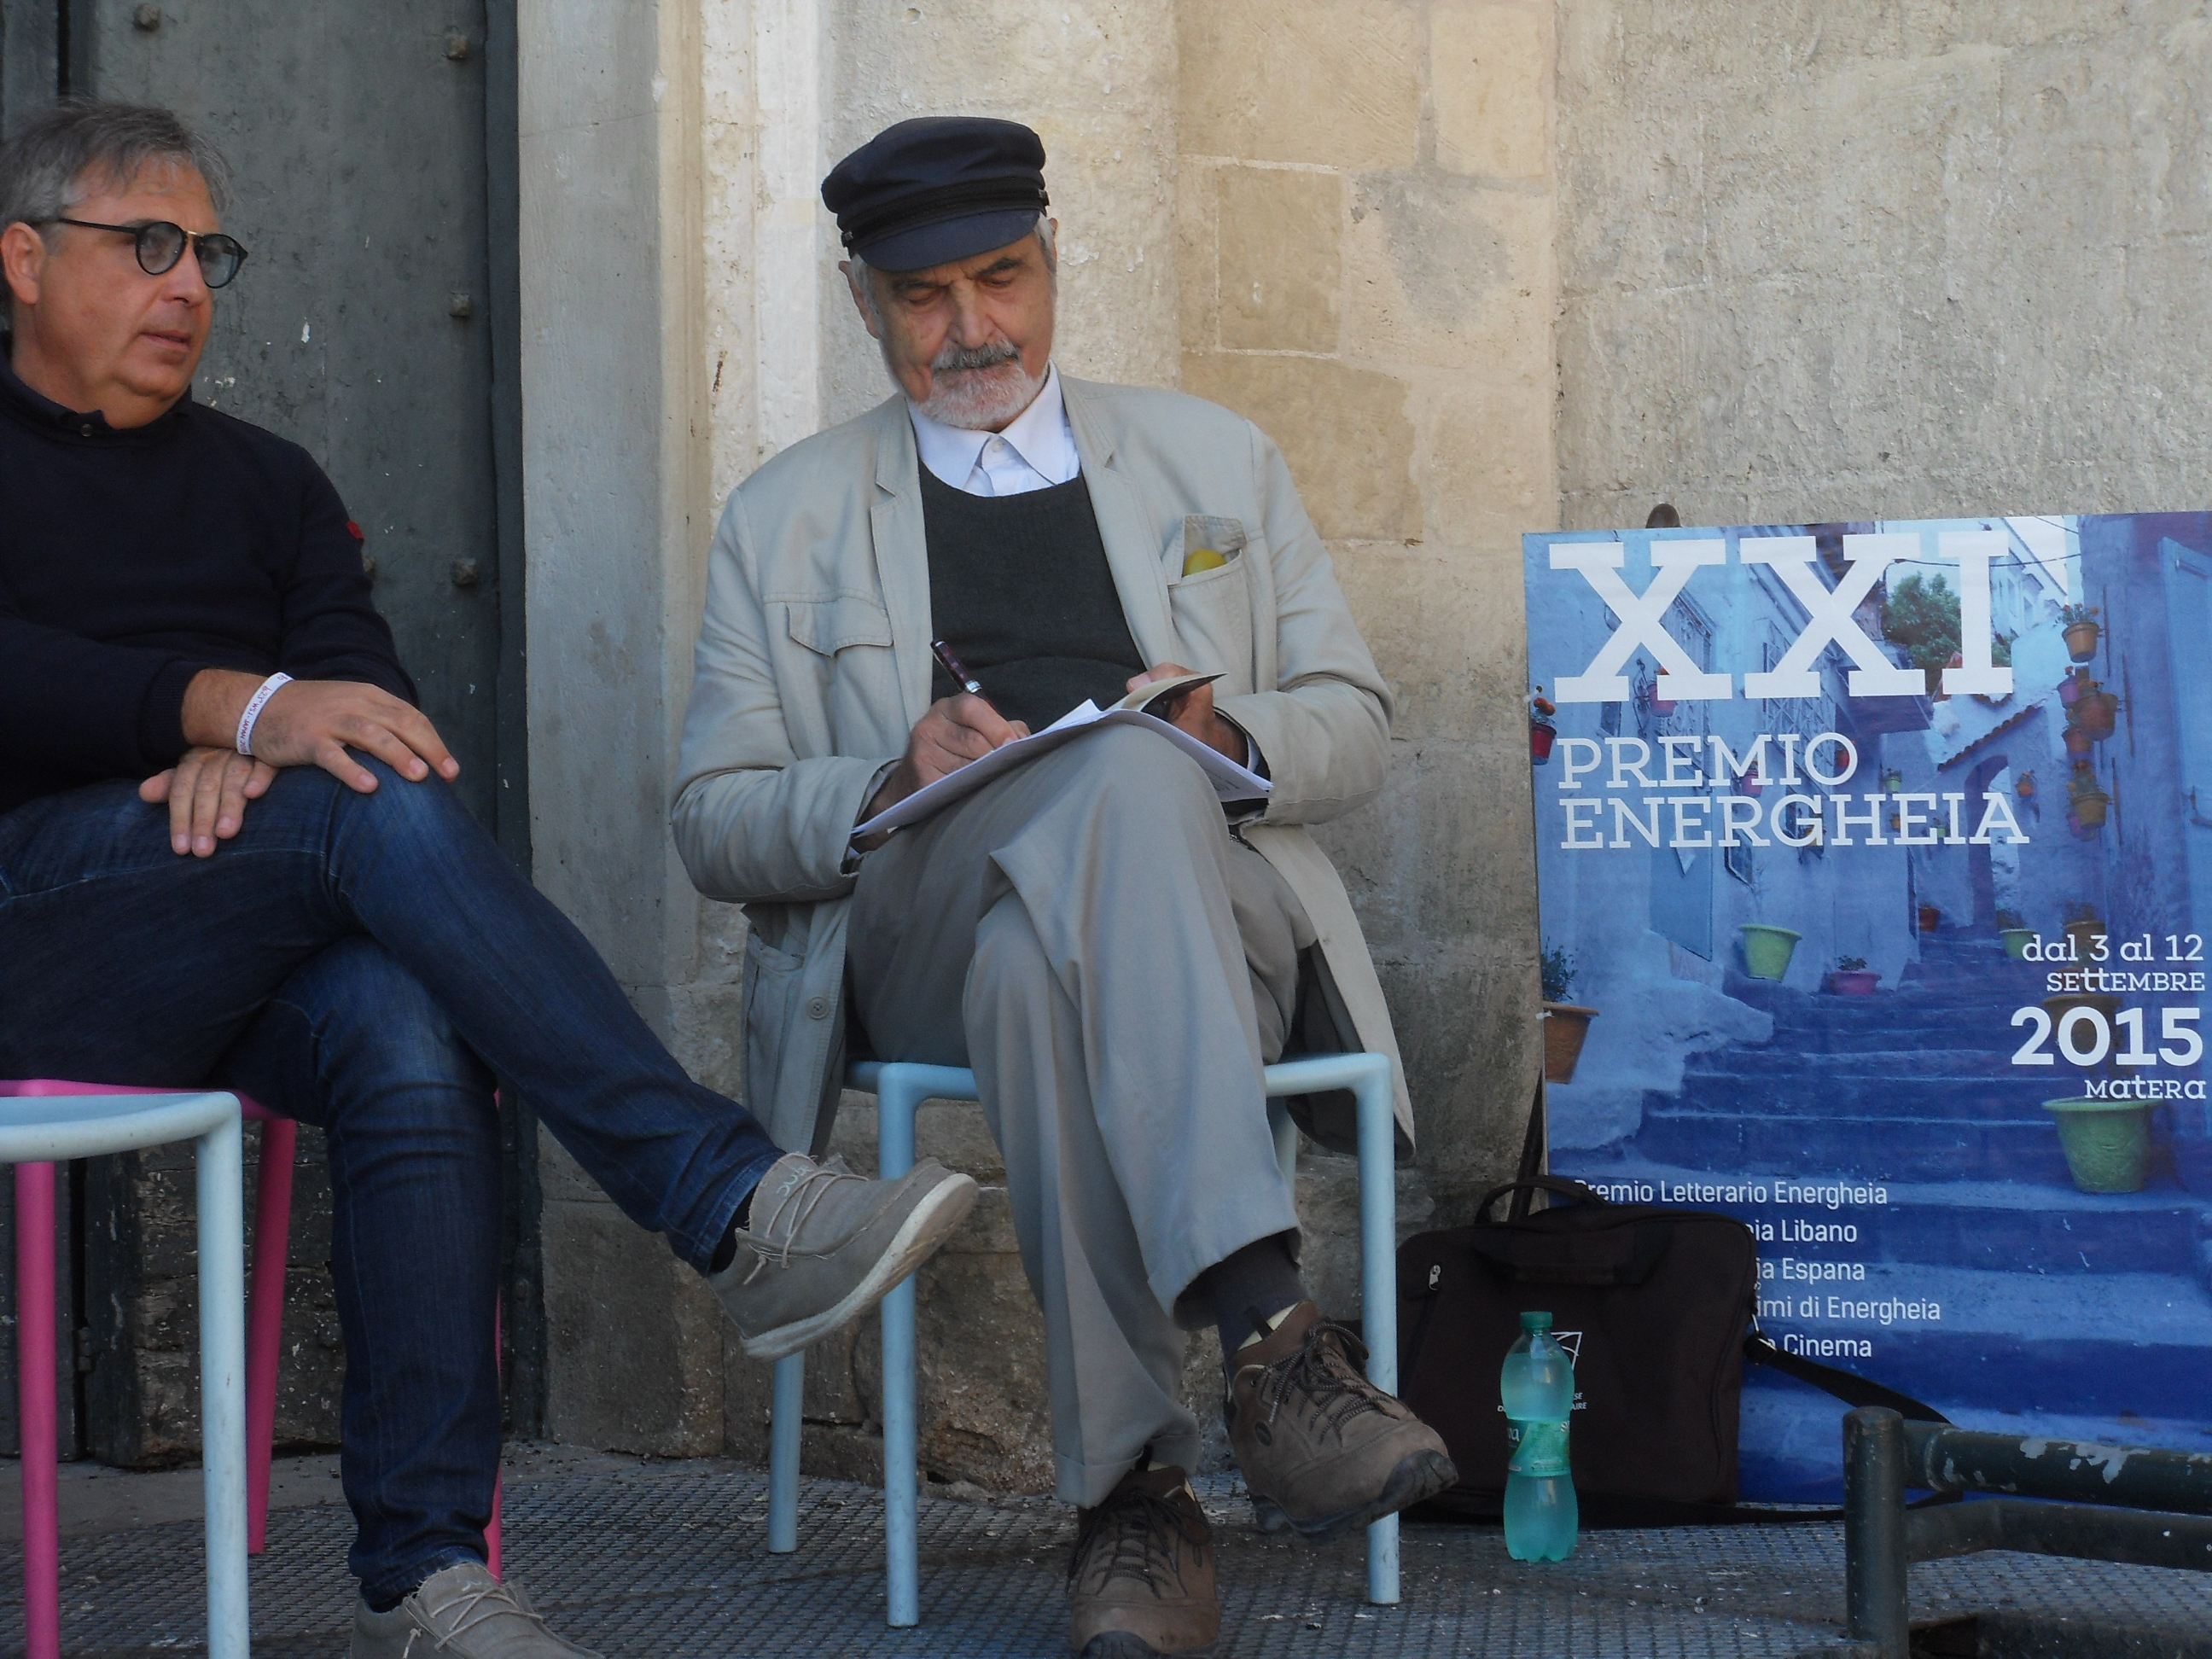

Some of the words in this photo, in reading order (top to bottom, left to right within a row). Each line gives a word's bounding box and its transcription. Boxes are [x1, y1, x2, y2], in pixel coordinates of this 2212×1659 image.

[1549, 531, 2013, 702] XXI
[1557, 731, 1859, 789] PREMIO
[1560, 792, 2030, 850] ENERGHEIA
[2022, 934, 2079, 962] dal
[2089, 934, 2110, 962] 3
[2120, 934, 2155, 962] al
[2165, 934, 2204, 961] 12
[2011, 1006, 2203, 1067] 2015
[1575, 1180, 1653, 1202] remio
[1661, 1180, 1767, 1203] Letterario
[1774, 1182, 1888, 1210] Energheia
[1782, 1220, 1857, 1242] Libano
[1783, 1258, 1865, 1284] Espana
[1800, 1296, 1819, 1318] di
[1827, 1296, 1941, 1325] Energheia
[1784, 1334, 1871, 1357] Cinema
